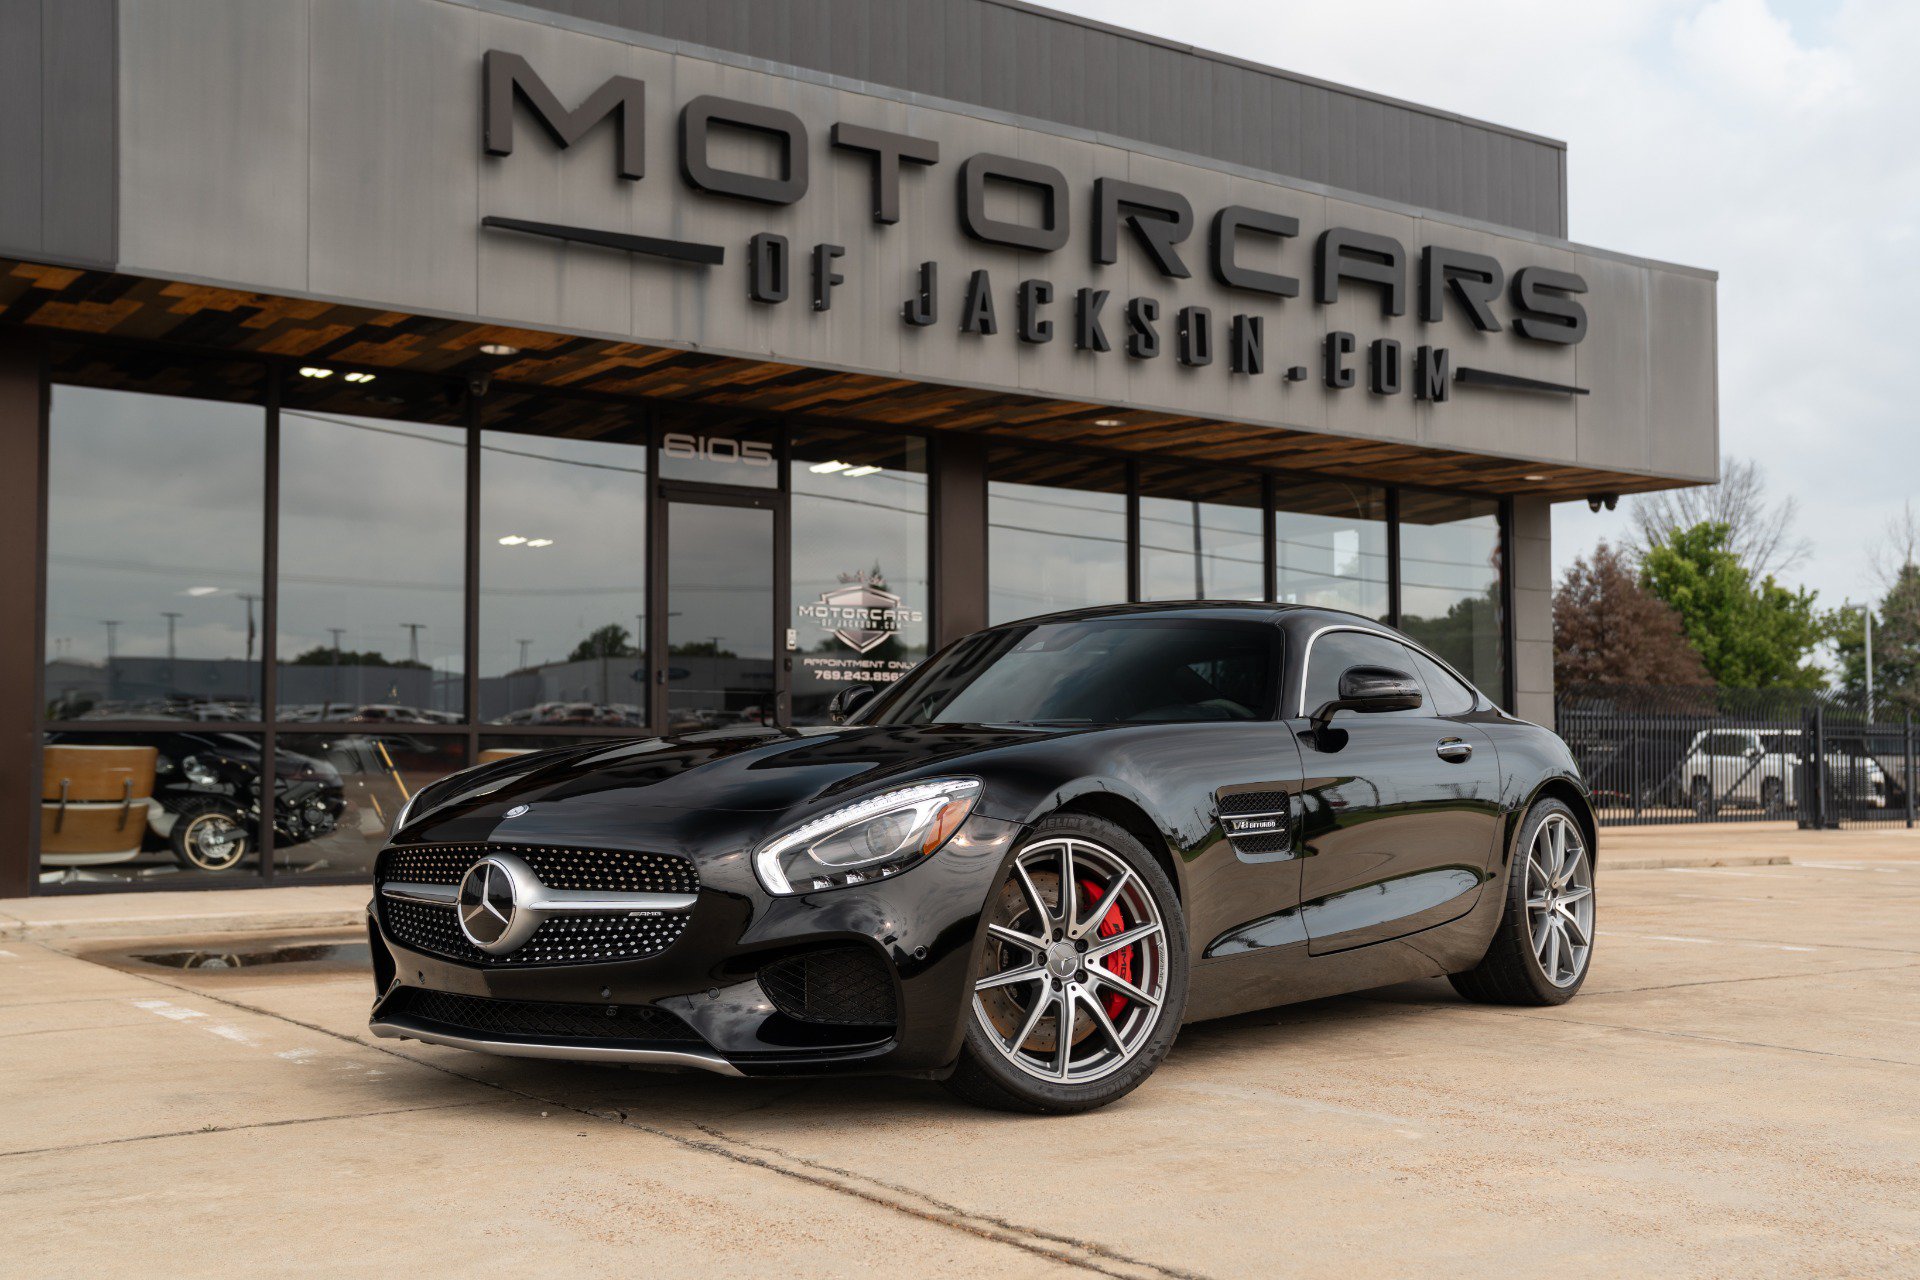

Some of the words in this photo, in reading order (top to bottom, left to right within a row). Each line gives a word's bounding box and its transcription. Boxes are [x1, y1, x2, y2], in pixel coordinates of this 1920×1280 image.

[481, 48, 1588, 345] MOTORCARS
[749, 232, 845, 311] OF
[902, 261, 1450, 402] JACKSON.COM
[663, 432, 774, 467] 6105
[798, 605, 923, 622] MOTORCARS
[803, 658, 885, 669] APPOINTMENT
[1231, 821, 1249, 830] V8
[1249, 821, 1277, 829] BITURBO
